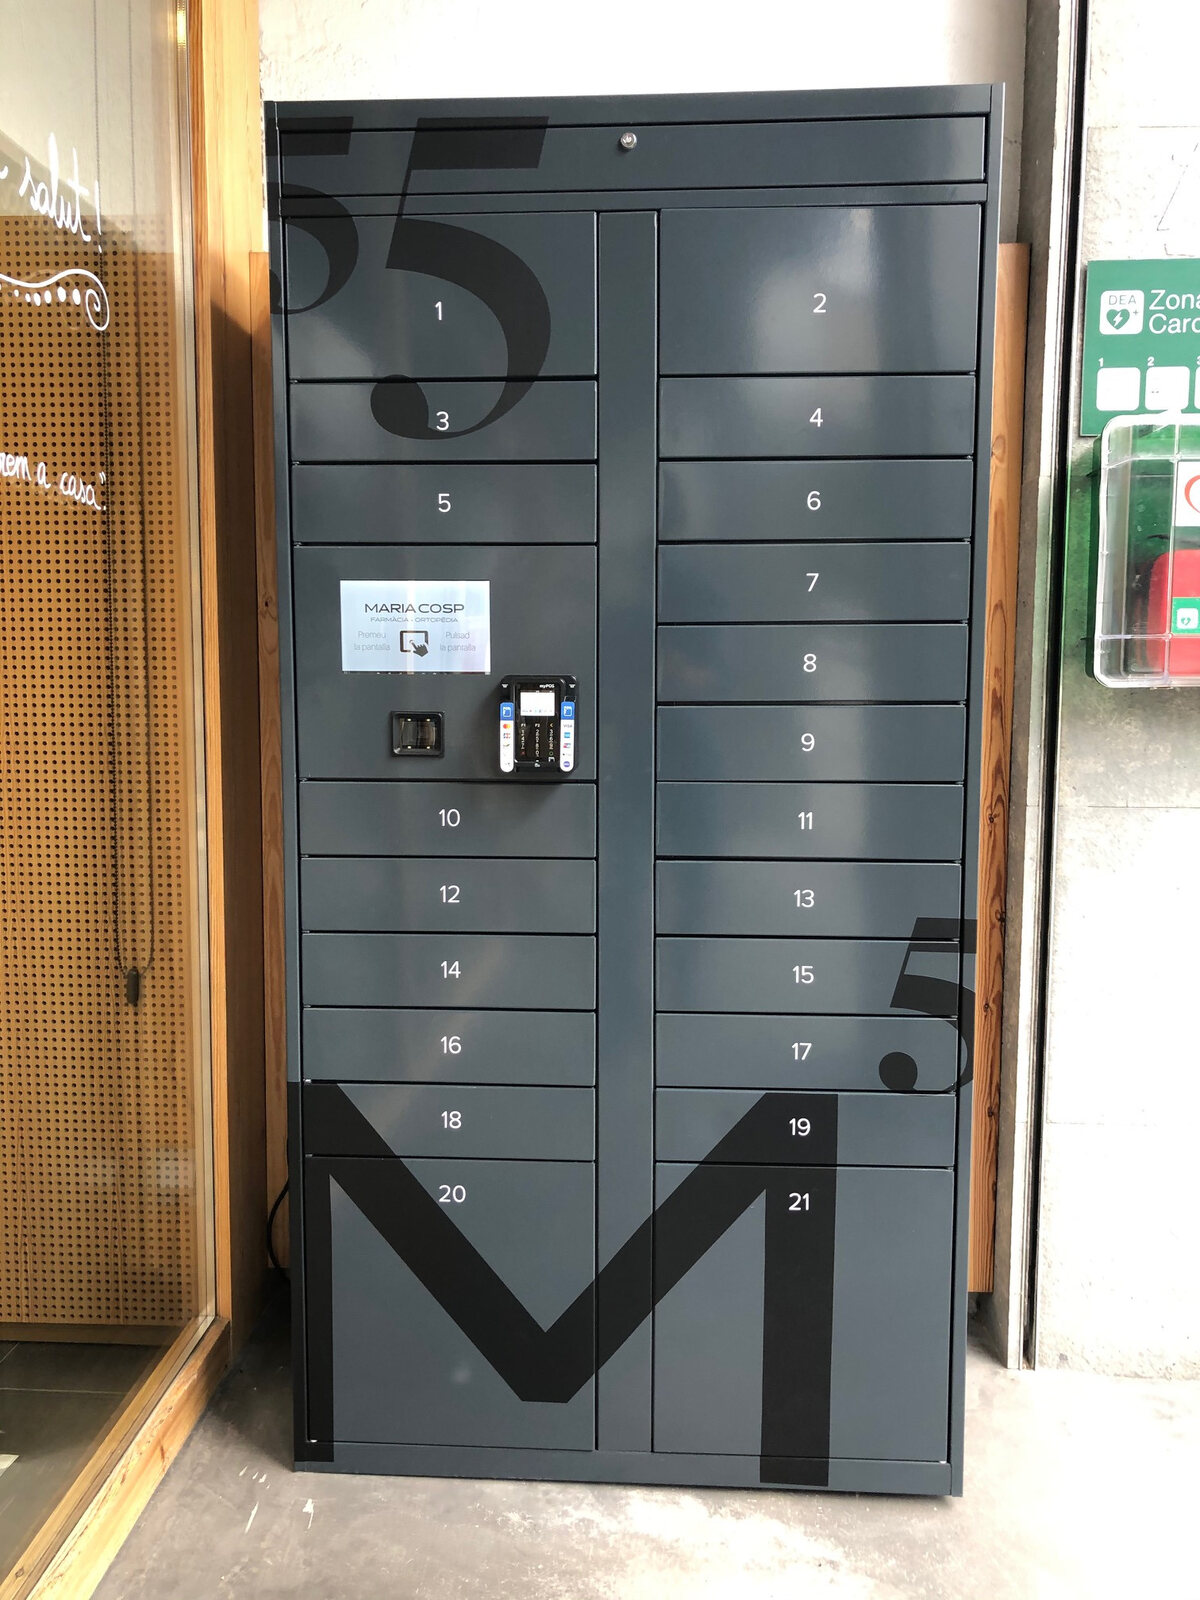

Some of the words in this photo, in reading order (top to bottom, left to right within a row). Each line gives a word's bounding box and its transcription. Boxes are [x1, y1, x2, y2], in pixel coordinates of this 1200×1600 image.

[370, 116, 551, 440] 5
[812, 293, 827, 313] 2
[1108, 294, 1137, 305] DEA
[435, 301, 443, 321] 1
[1098, 357, 1104, 367] 1
[1147, 356, 1155, 366] 2
[435, 411, 450, 431] 3
[809, 408, 824, 427] 4
[37, 461, 51, 489] a
[437, 493, 452, 513] 5
[806, 491, 821, 511] 6
[806, 573, 820, 592] 7
[364, 603, 417, 614] MARIA
[418, 603, 465, 614] COSP
[357, 630, 387, 639] Premeu
[445, 631, 471, 639] Pulsad
[353, 643, 361, 651] la
[362, 643, 391, 653] pantalla
[440, 643, 446, 652] la
[447, 643, 476, 654] pantalla
[802, 654, 817, 673] 8
[800, 733, 815, 752] 9
[438, 809, 461, 827] 10
[797, 812, 813, 830] 11
[440, 885, 461, 904] 12
[793, 890, 815, 908] 13
[440, 960, 462, 978] 14
[793, 966, 815, 984] 15
[440, 1036, 462, 1054] 16
[791, 1042, 813, 1060] 17
[441, 1111, 462, 1129] 18
[789, 1118, 811, 1136] 19
[438, 1185, 467, 1203] 20
[788, 1193, 810, 1211] 21
